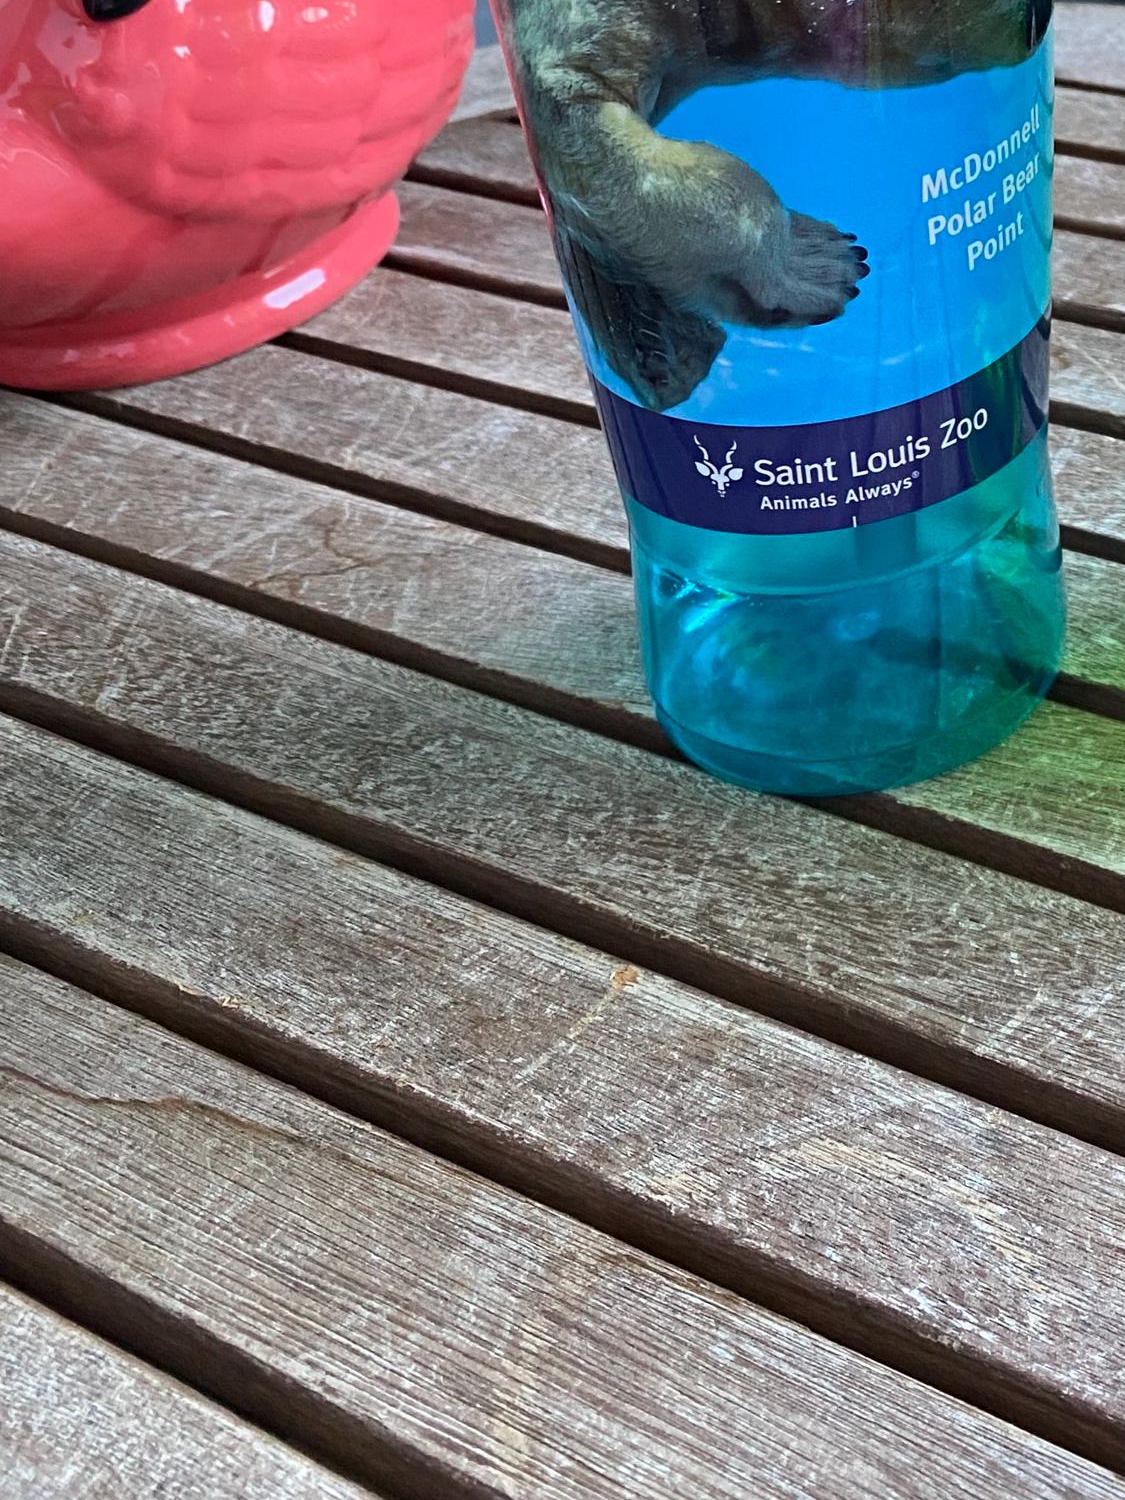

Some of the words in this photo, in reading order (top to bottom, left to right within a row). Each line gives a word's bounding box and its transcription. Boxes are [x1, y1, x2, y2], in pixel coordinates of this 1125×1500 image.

[922, 104, 1040, 203] McDonnell
[928, 191, 997, 245] Polar
[1002, 152, 1040, 204] Bear
[967, 211, 1024, 271] Point
[754, 457, 838, 487] Saint
[850, 434, 931, 478] Louis
[939, 408, 988, 449] Zoo
[760, 493, 837, 511] Animals
